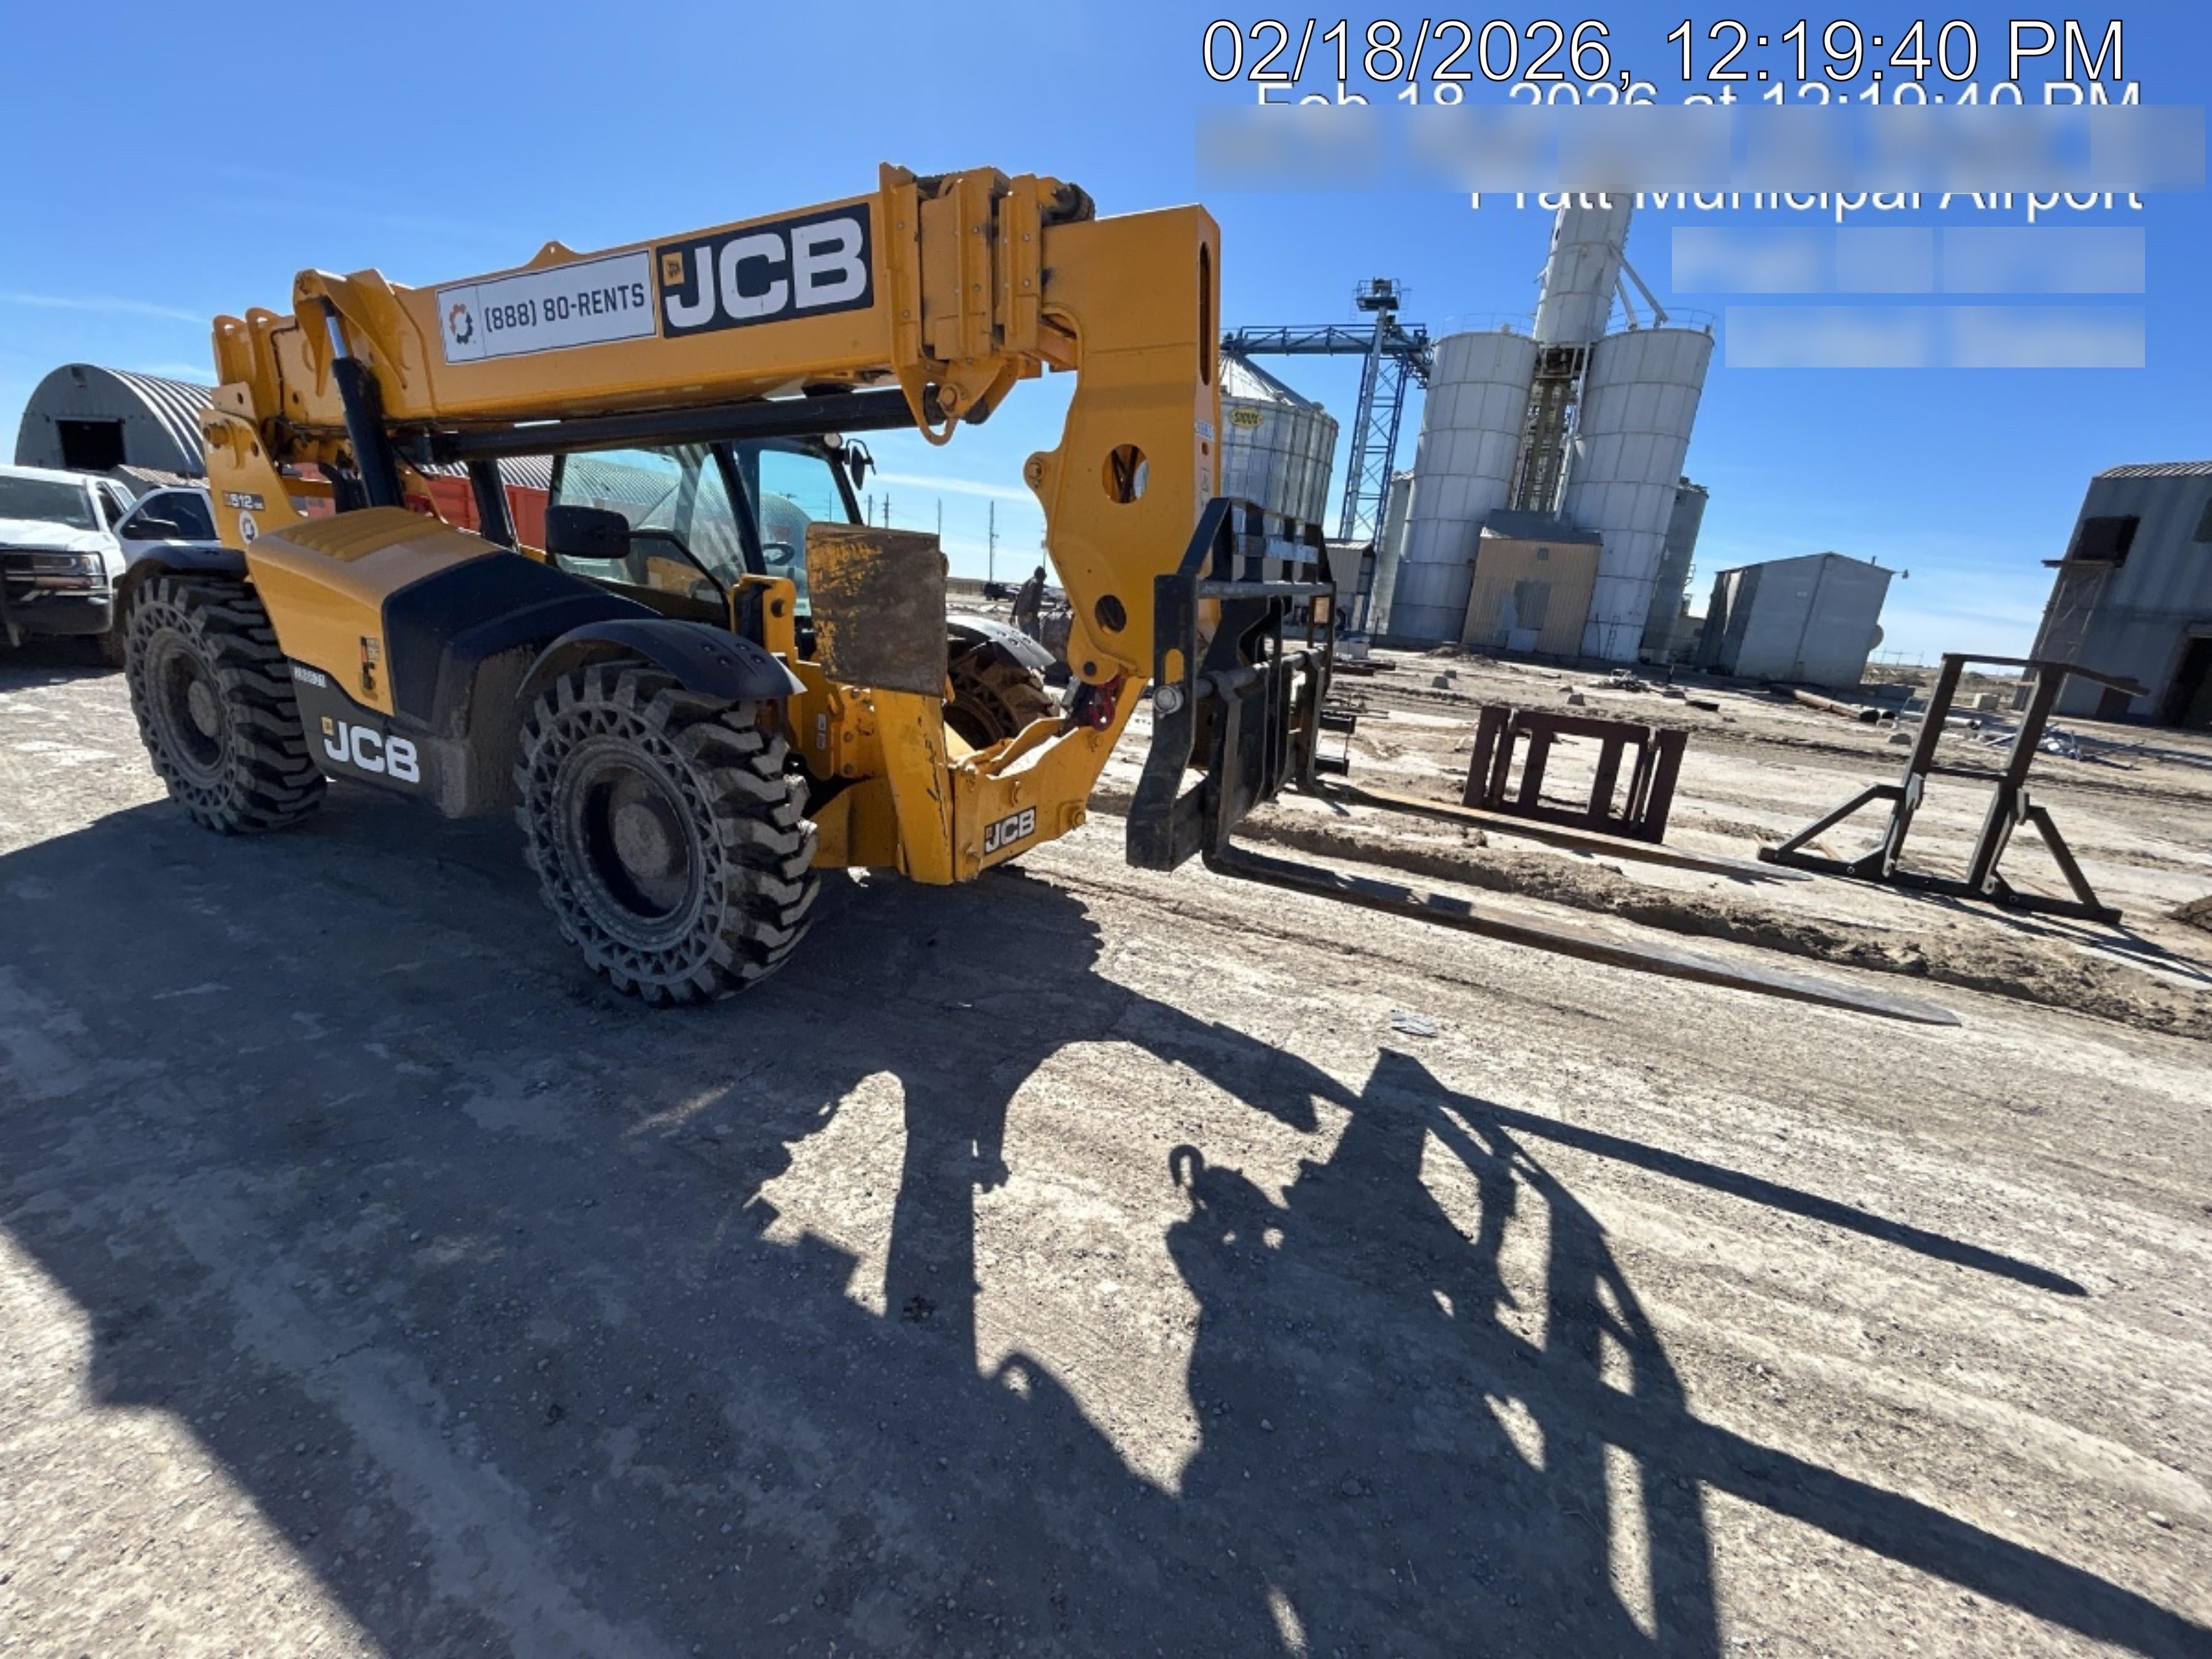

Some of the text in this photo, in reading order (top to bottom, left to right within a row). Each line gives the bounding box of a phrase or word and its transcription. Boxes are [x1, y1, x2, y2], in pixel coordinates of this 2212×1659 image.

[665, 217, 867, 327] JCB
[485, 283, 645, 332] (888) 80-RENTS
[324, 720, 420, 783] JCB
[985, 809, 1035, 852] JCB
